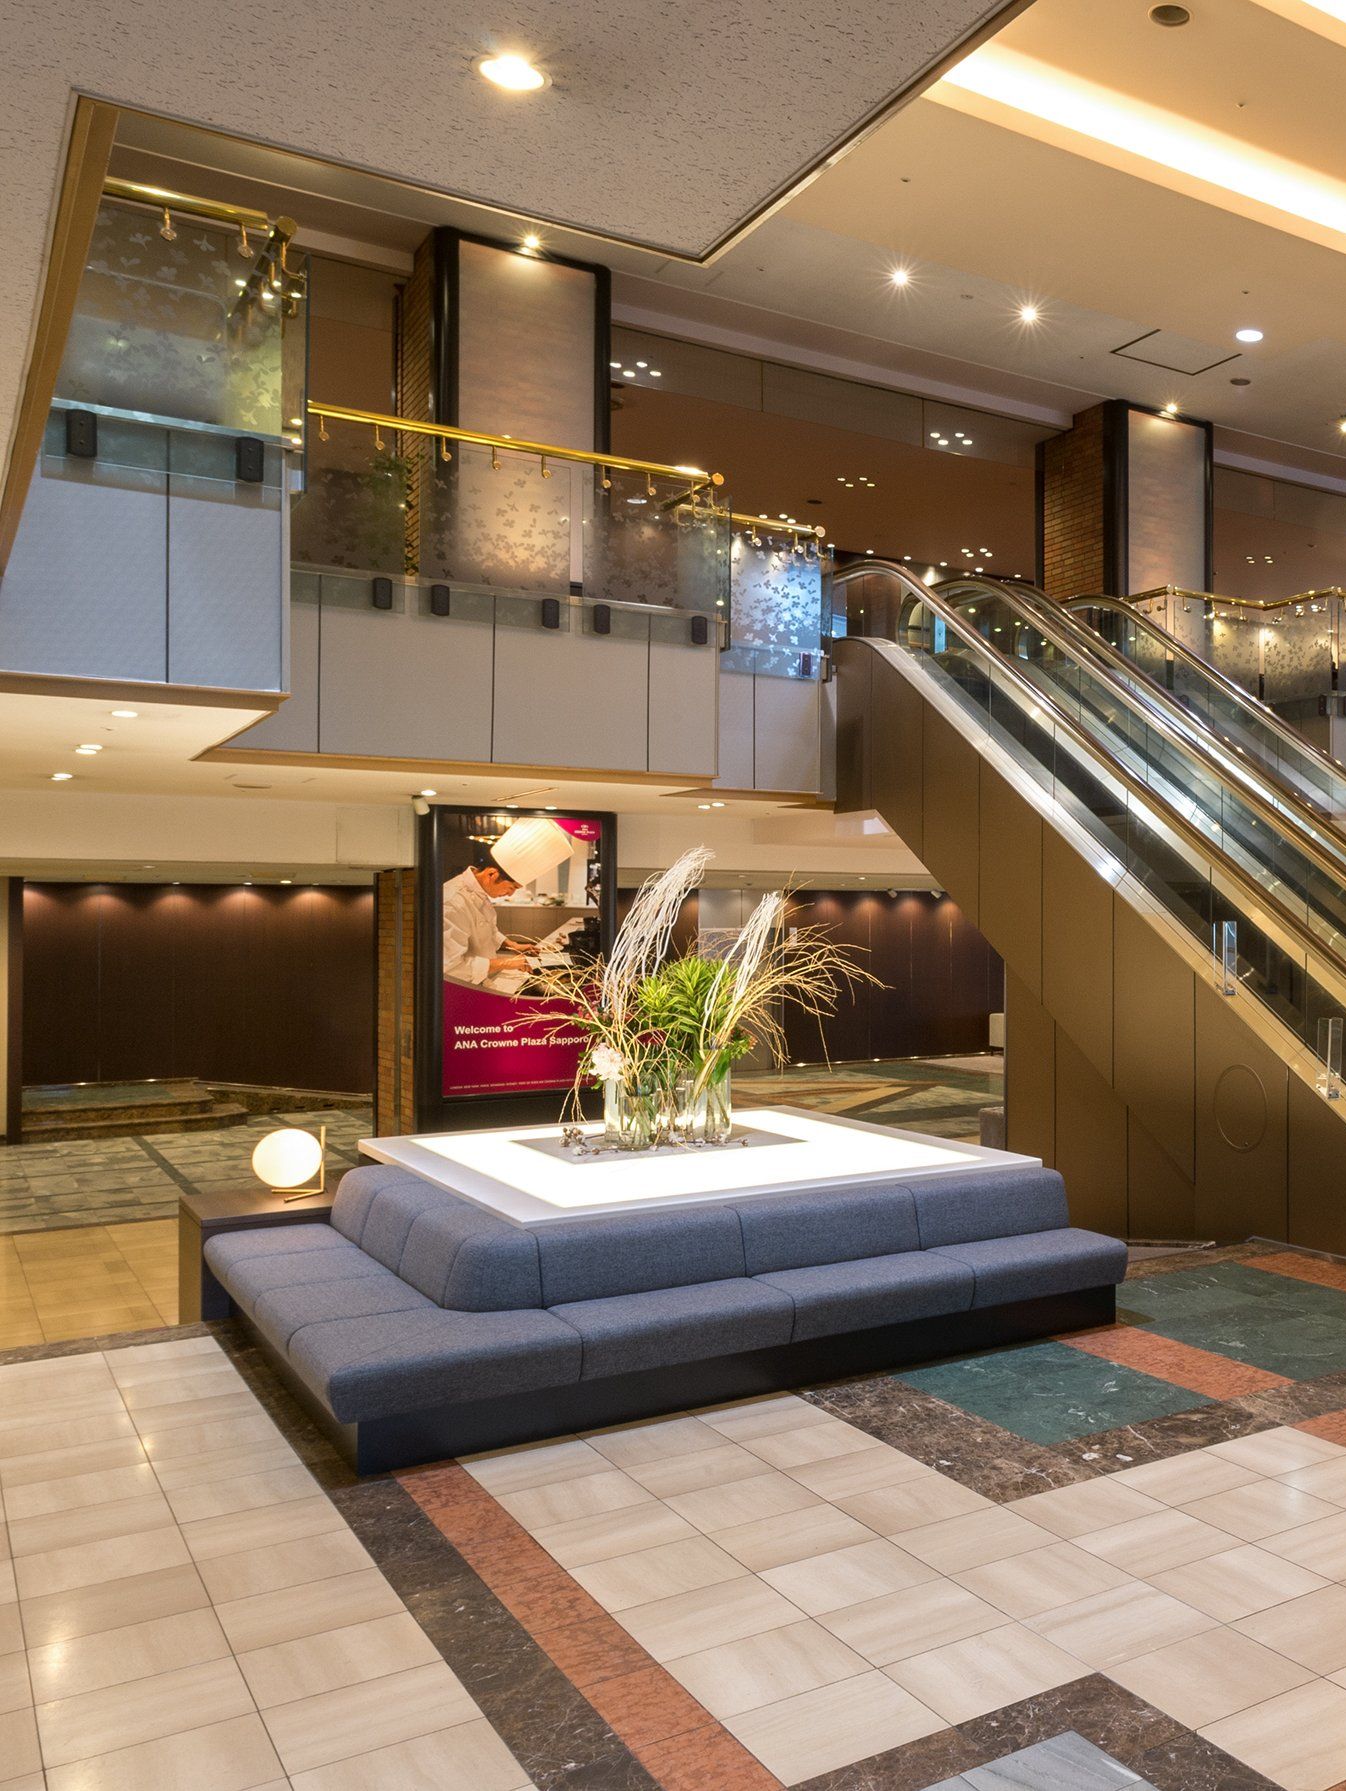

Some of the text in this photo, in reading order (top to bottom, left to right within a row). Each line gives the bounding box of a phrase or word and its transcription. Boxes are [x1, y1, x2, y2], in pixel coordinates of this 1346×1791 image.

[454, 1024, 514, 1035] Welcome to
[454, 1036, 589, 1050] ANA Crowne Plaza Sapporo
